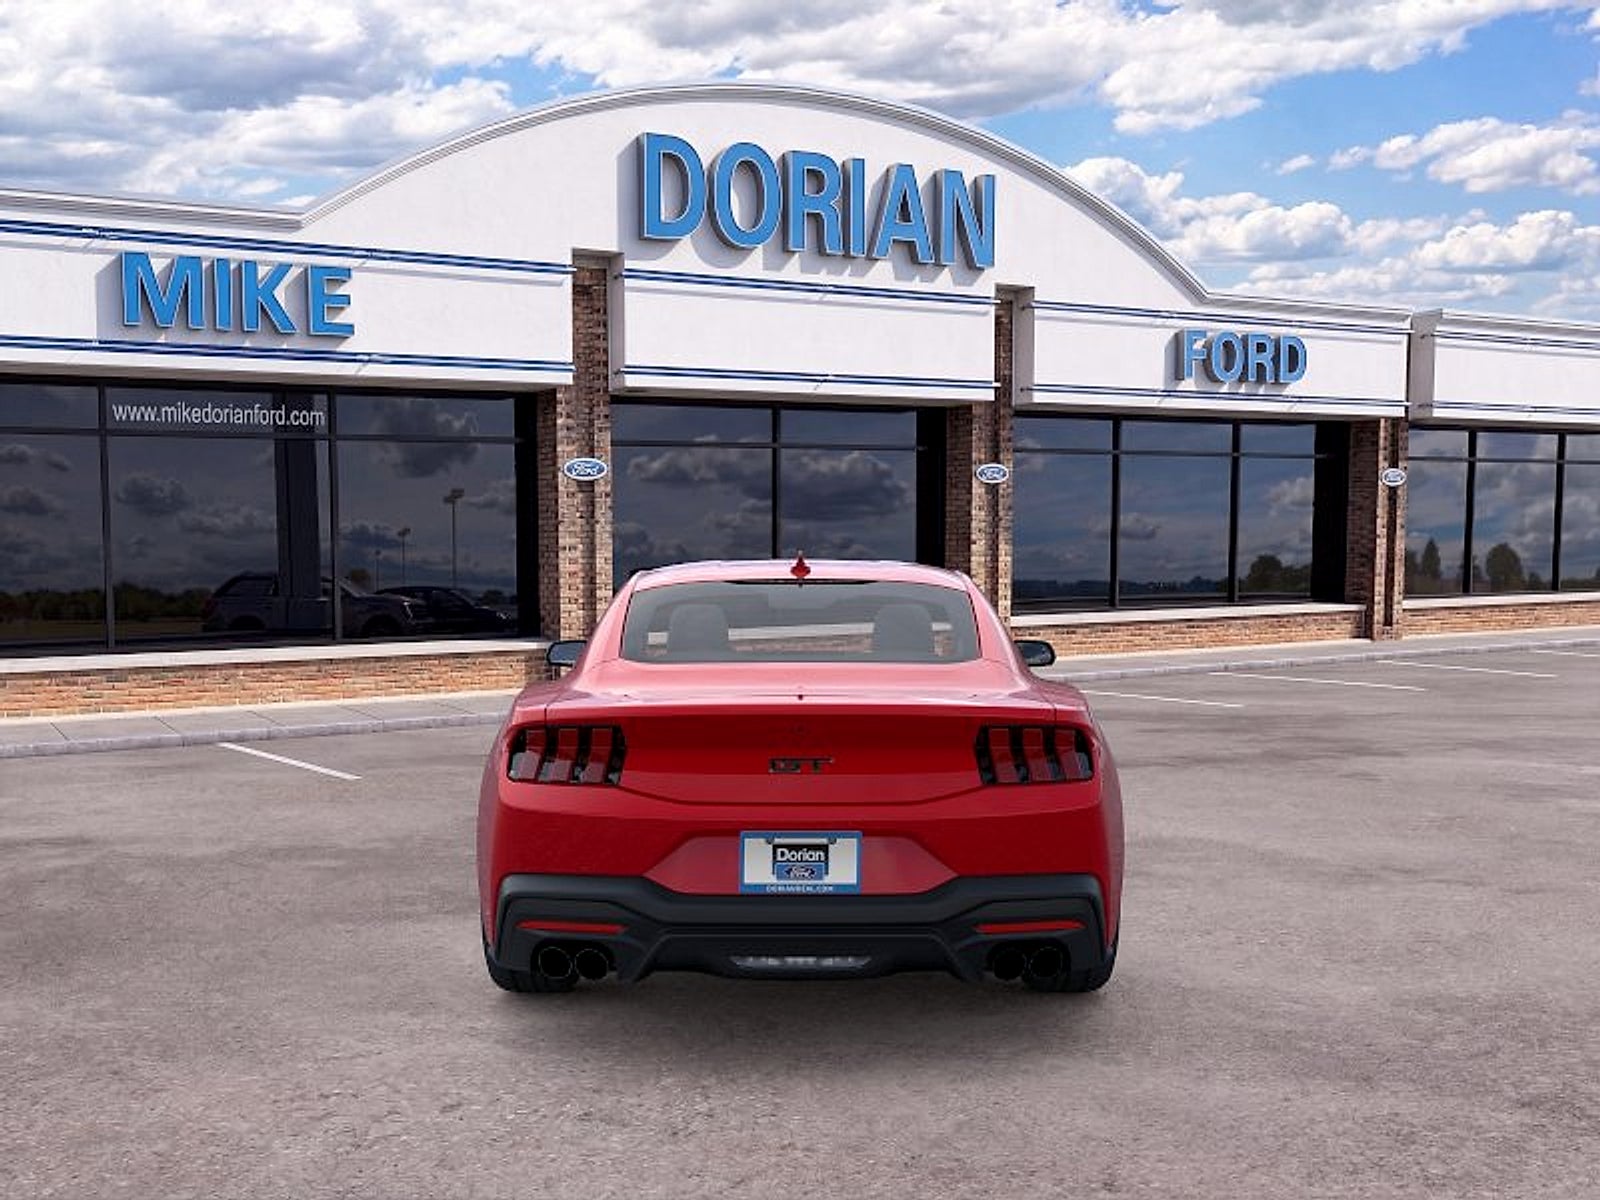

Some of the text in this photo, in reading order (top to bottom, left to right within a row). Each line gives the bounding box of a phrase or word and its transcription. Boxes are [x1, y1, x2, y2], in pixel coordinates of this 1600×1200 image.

[641, 132, 996, 269] DORIAN
[121, 251, 355, 337] MIKE
[1181, 328, 1307, 384] FORD
[111, 402, 326, 427] www.mikedorianford.com
[768, 757, 834, 773] GT
[776, 847, 825, 862] Dorian
